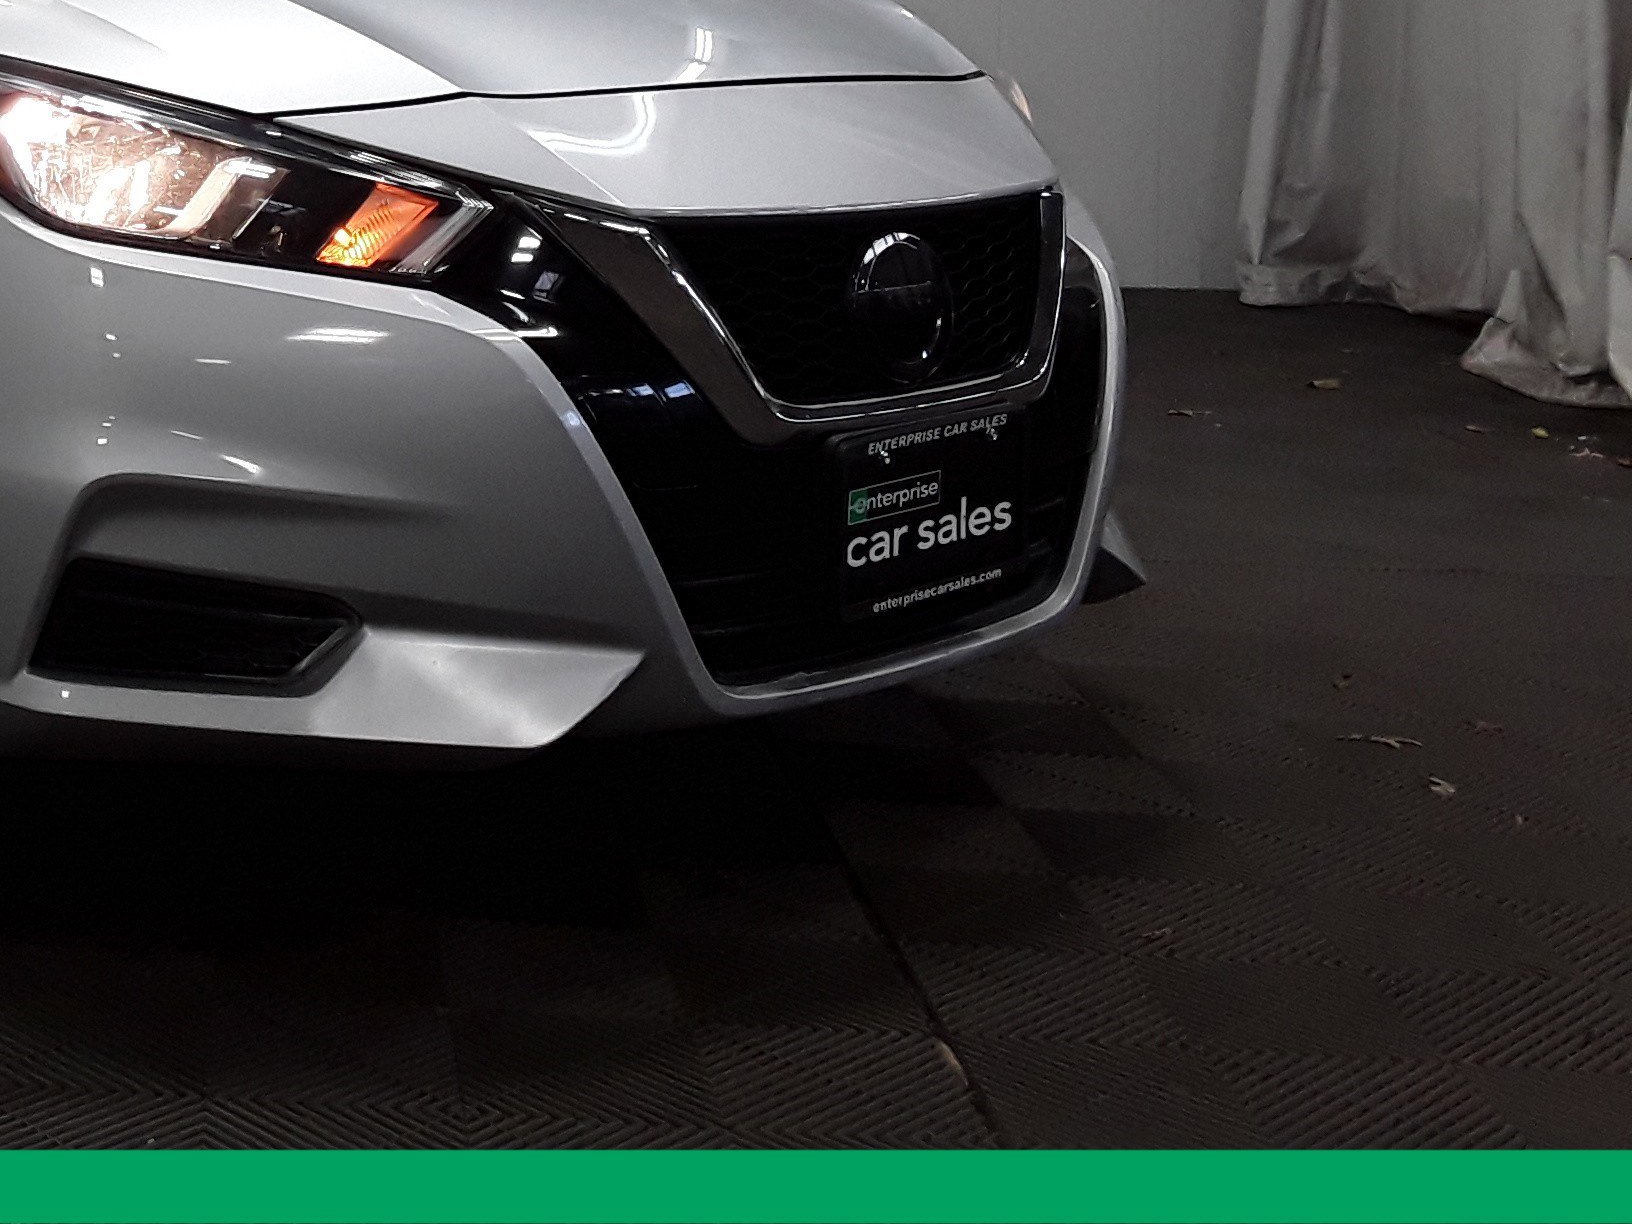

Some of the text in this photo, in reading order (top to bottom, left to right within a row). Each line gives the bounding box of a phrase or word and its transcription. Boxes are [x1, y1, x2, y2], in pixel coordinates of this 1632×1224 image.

[868, 413, 1008, 455] ENTERPRISE CAR SALES
[852, 481, 939, 514] enterprise
[846, 496, 1012, 568] car sales
[872, 568, 1003, 613] enterprisecarsales.com
